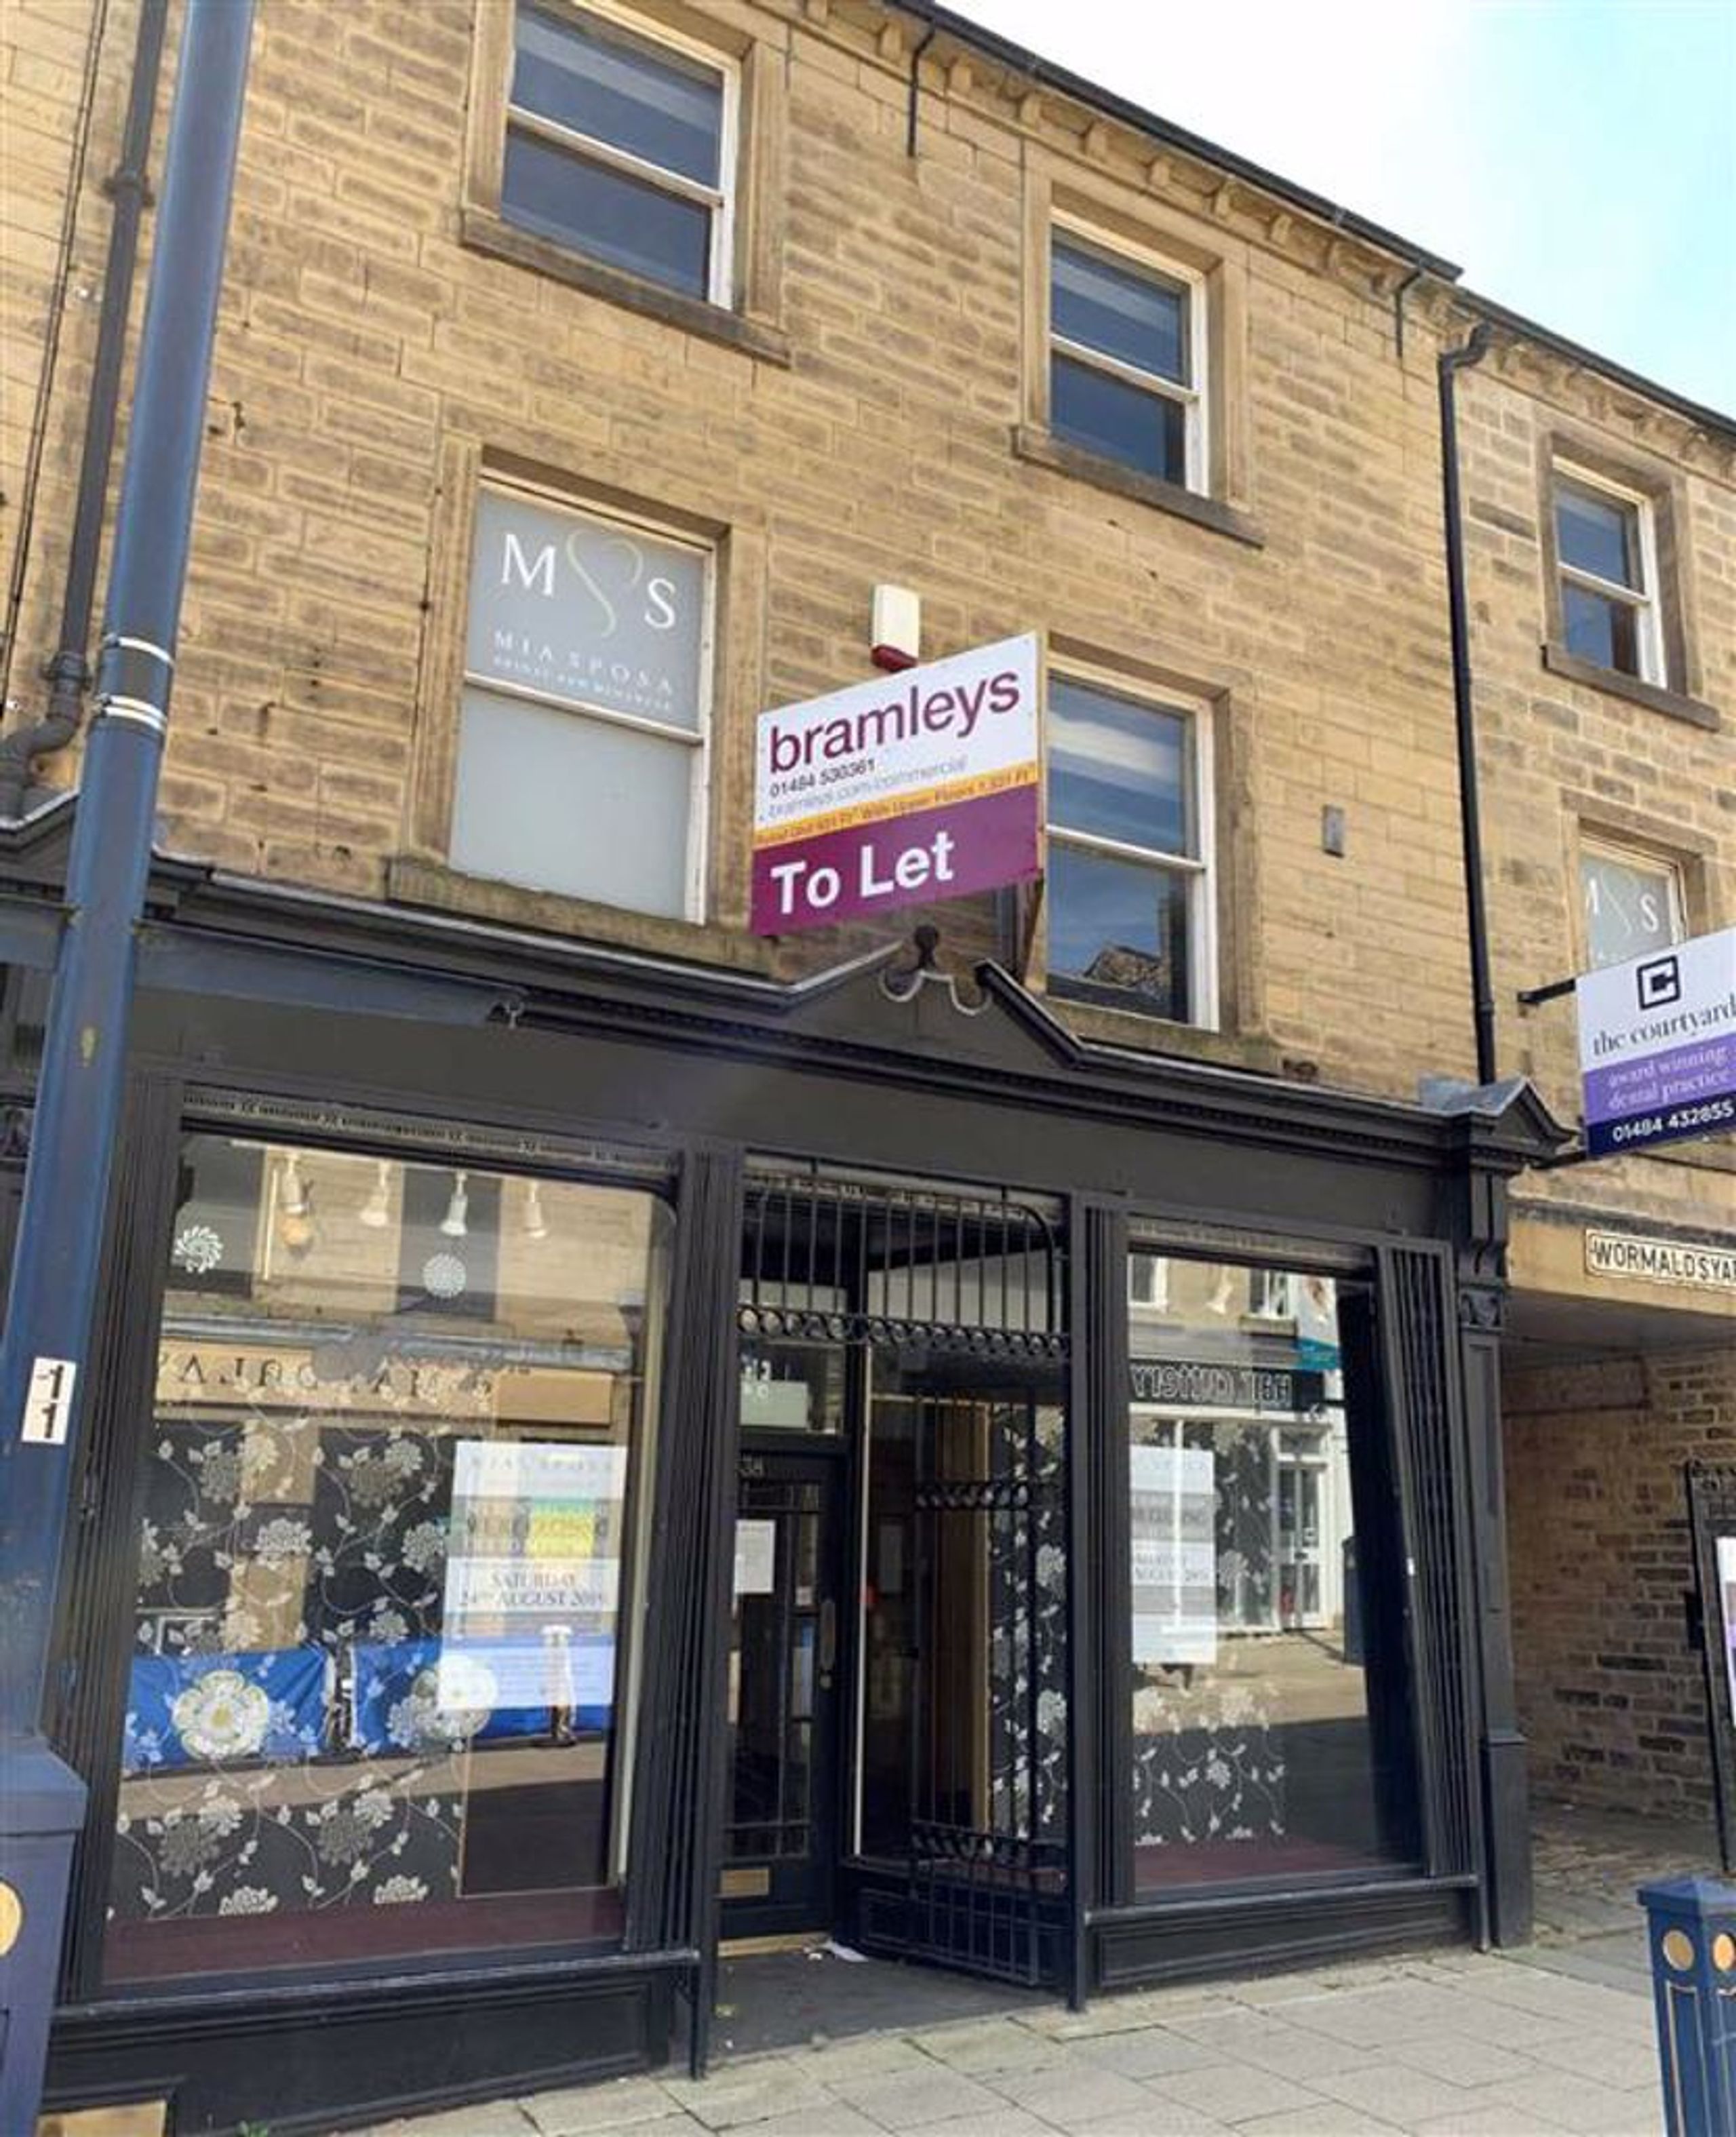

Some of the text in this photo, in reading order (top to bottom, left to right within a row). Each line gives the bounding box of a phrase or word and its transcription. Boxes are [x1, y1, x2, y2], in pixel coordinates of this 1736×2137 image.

[770, 670, 1020, 774] bramleys
[770, 831, 955, 914] To Let
[1594, 994, 1736, 1055] the courtyard
[1612, 1116, 1663, 1143] 01484
